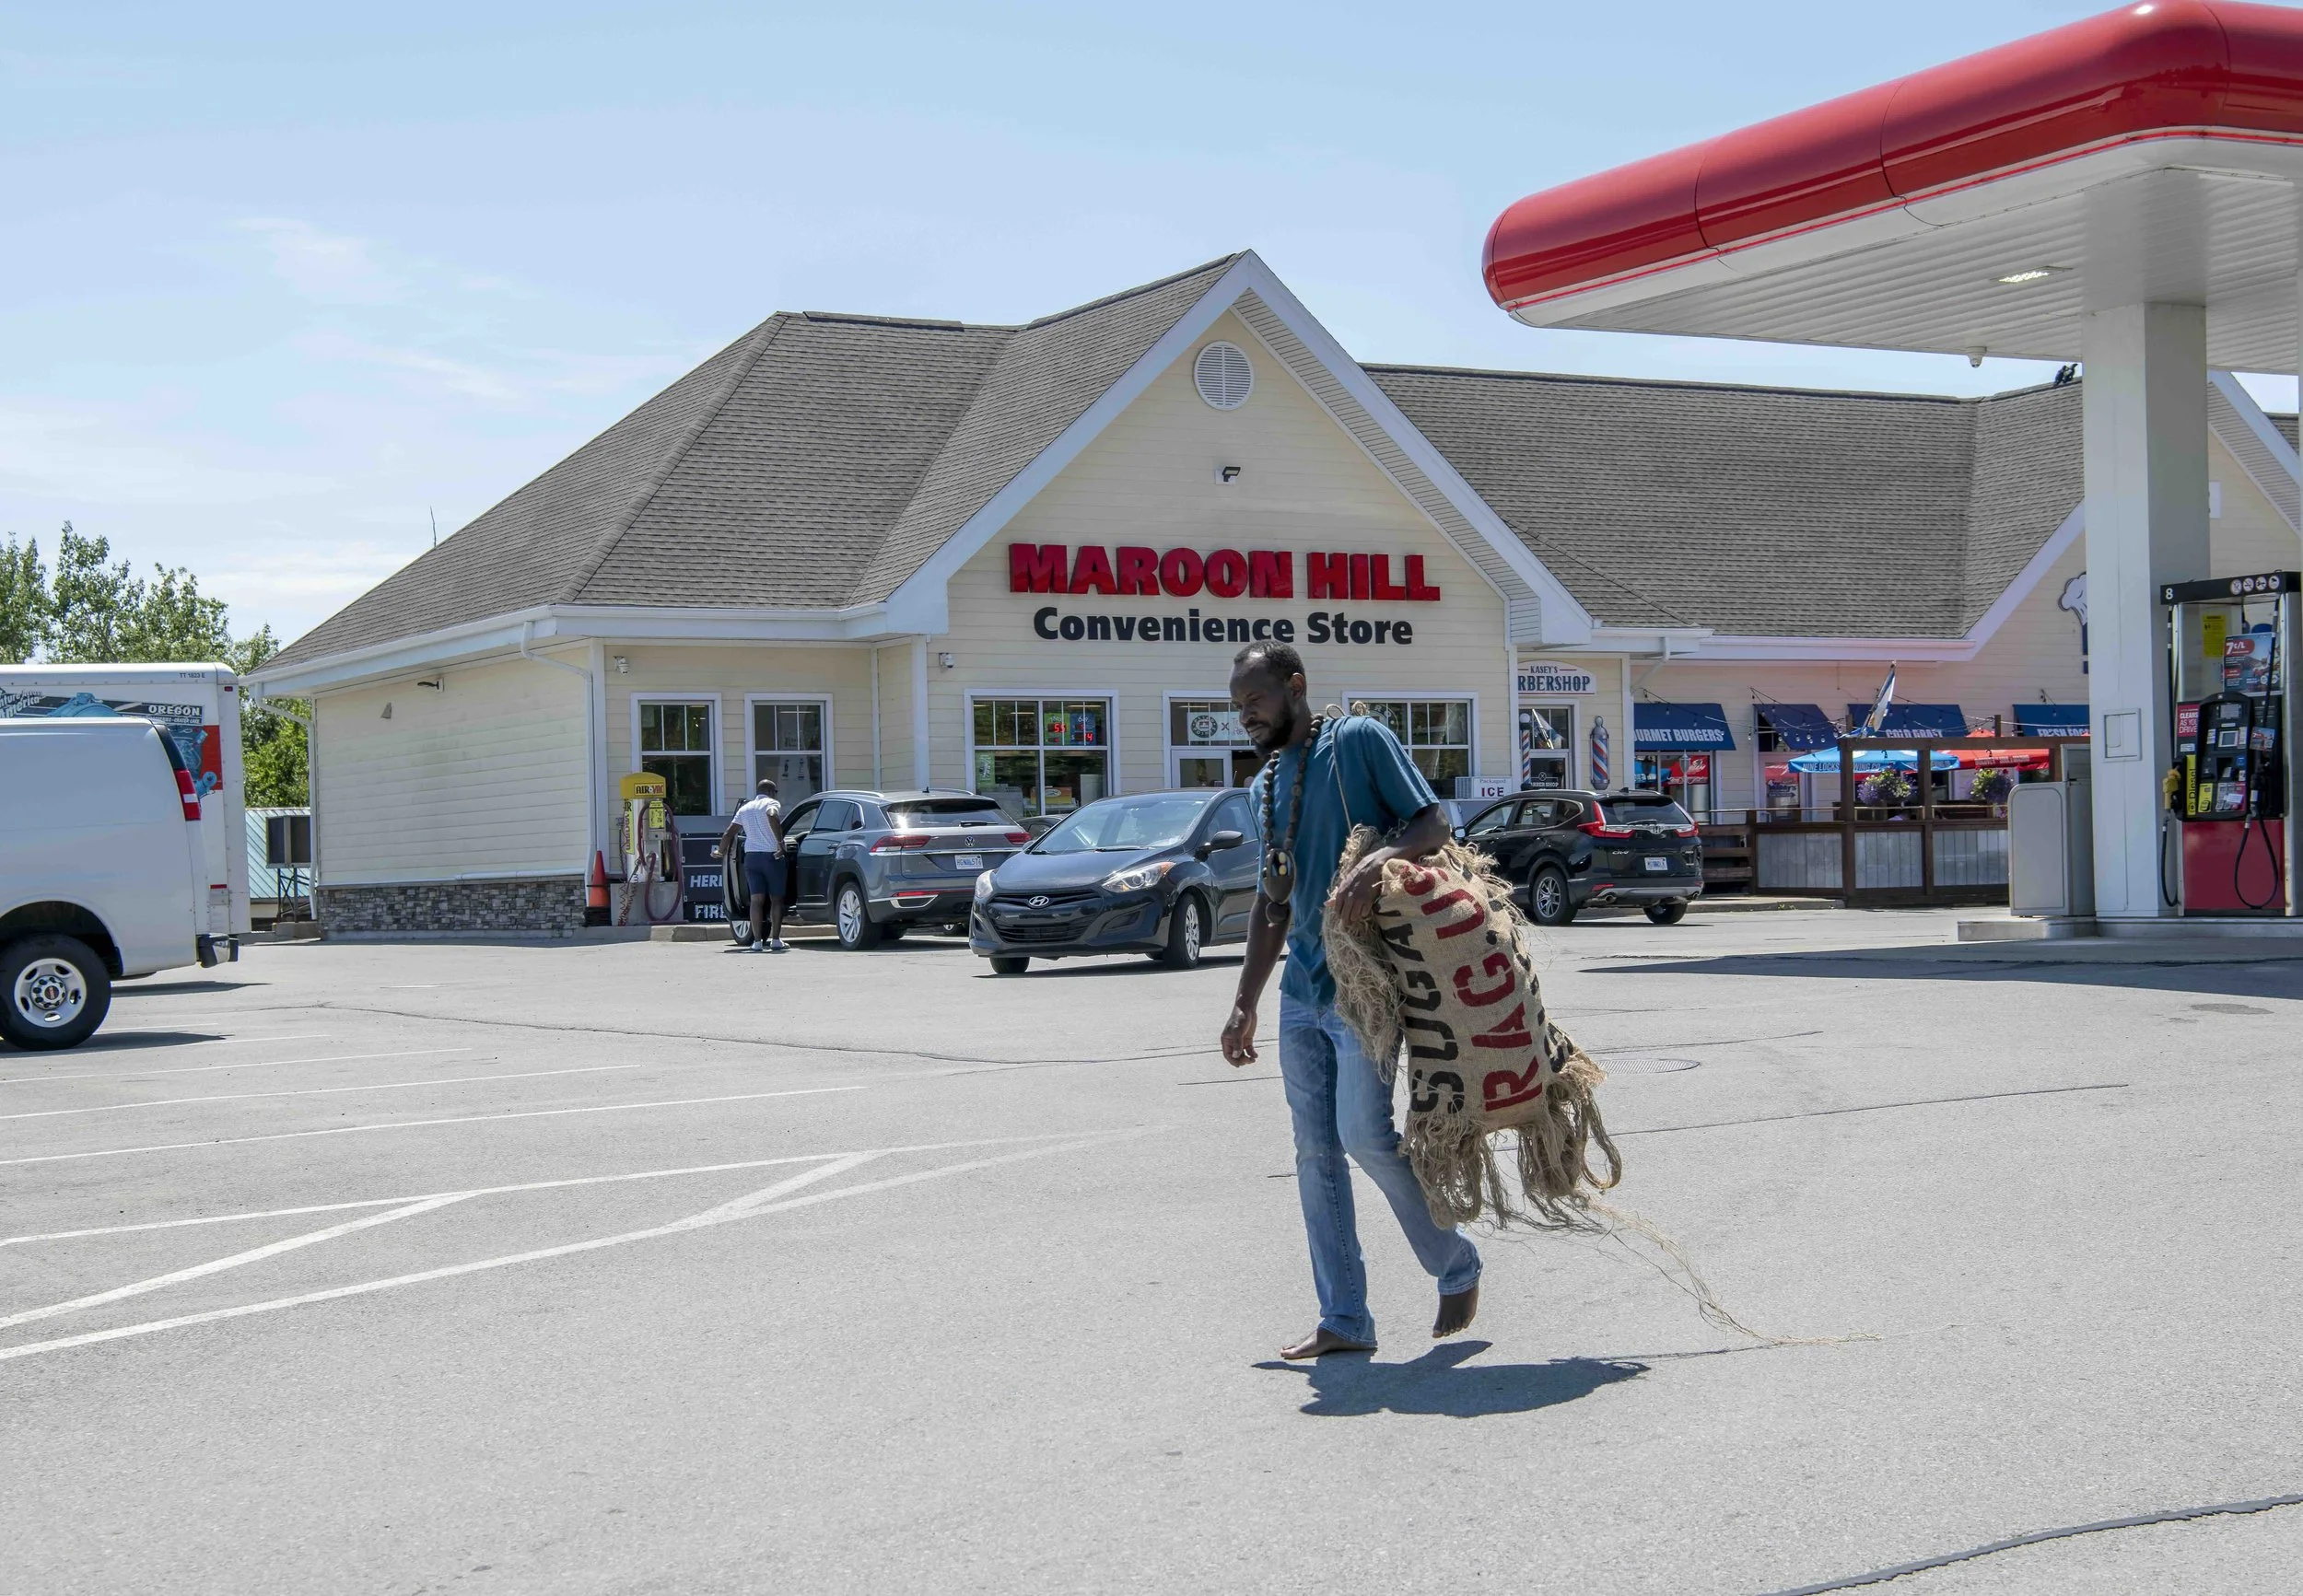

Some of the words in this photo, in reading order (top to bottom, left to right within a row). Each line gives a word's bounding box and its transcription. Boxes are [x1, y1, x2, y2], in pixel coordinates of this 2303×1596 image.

[1009, 542, 1293, 600] MAROON
[1306, 552, 1441, 601] HILL
[2165, 588, 2174, 600] 8
[1034, 606, 1295, 644] Convenience
[1307, 612, 1413, 645] Store
[1530, 665, 1558, 673] KASEY'S
[147, 705, 201, 716] OREGON
[2178, 725, 2198, 734] DRIVE
[1675, 729, 1724, 742] BURGERS
[1818, 763, 1841, 772] LOCKS
[636, 785, 649, 794] AIR
[1481, 786, 1504, 798] ICE
